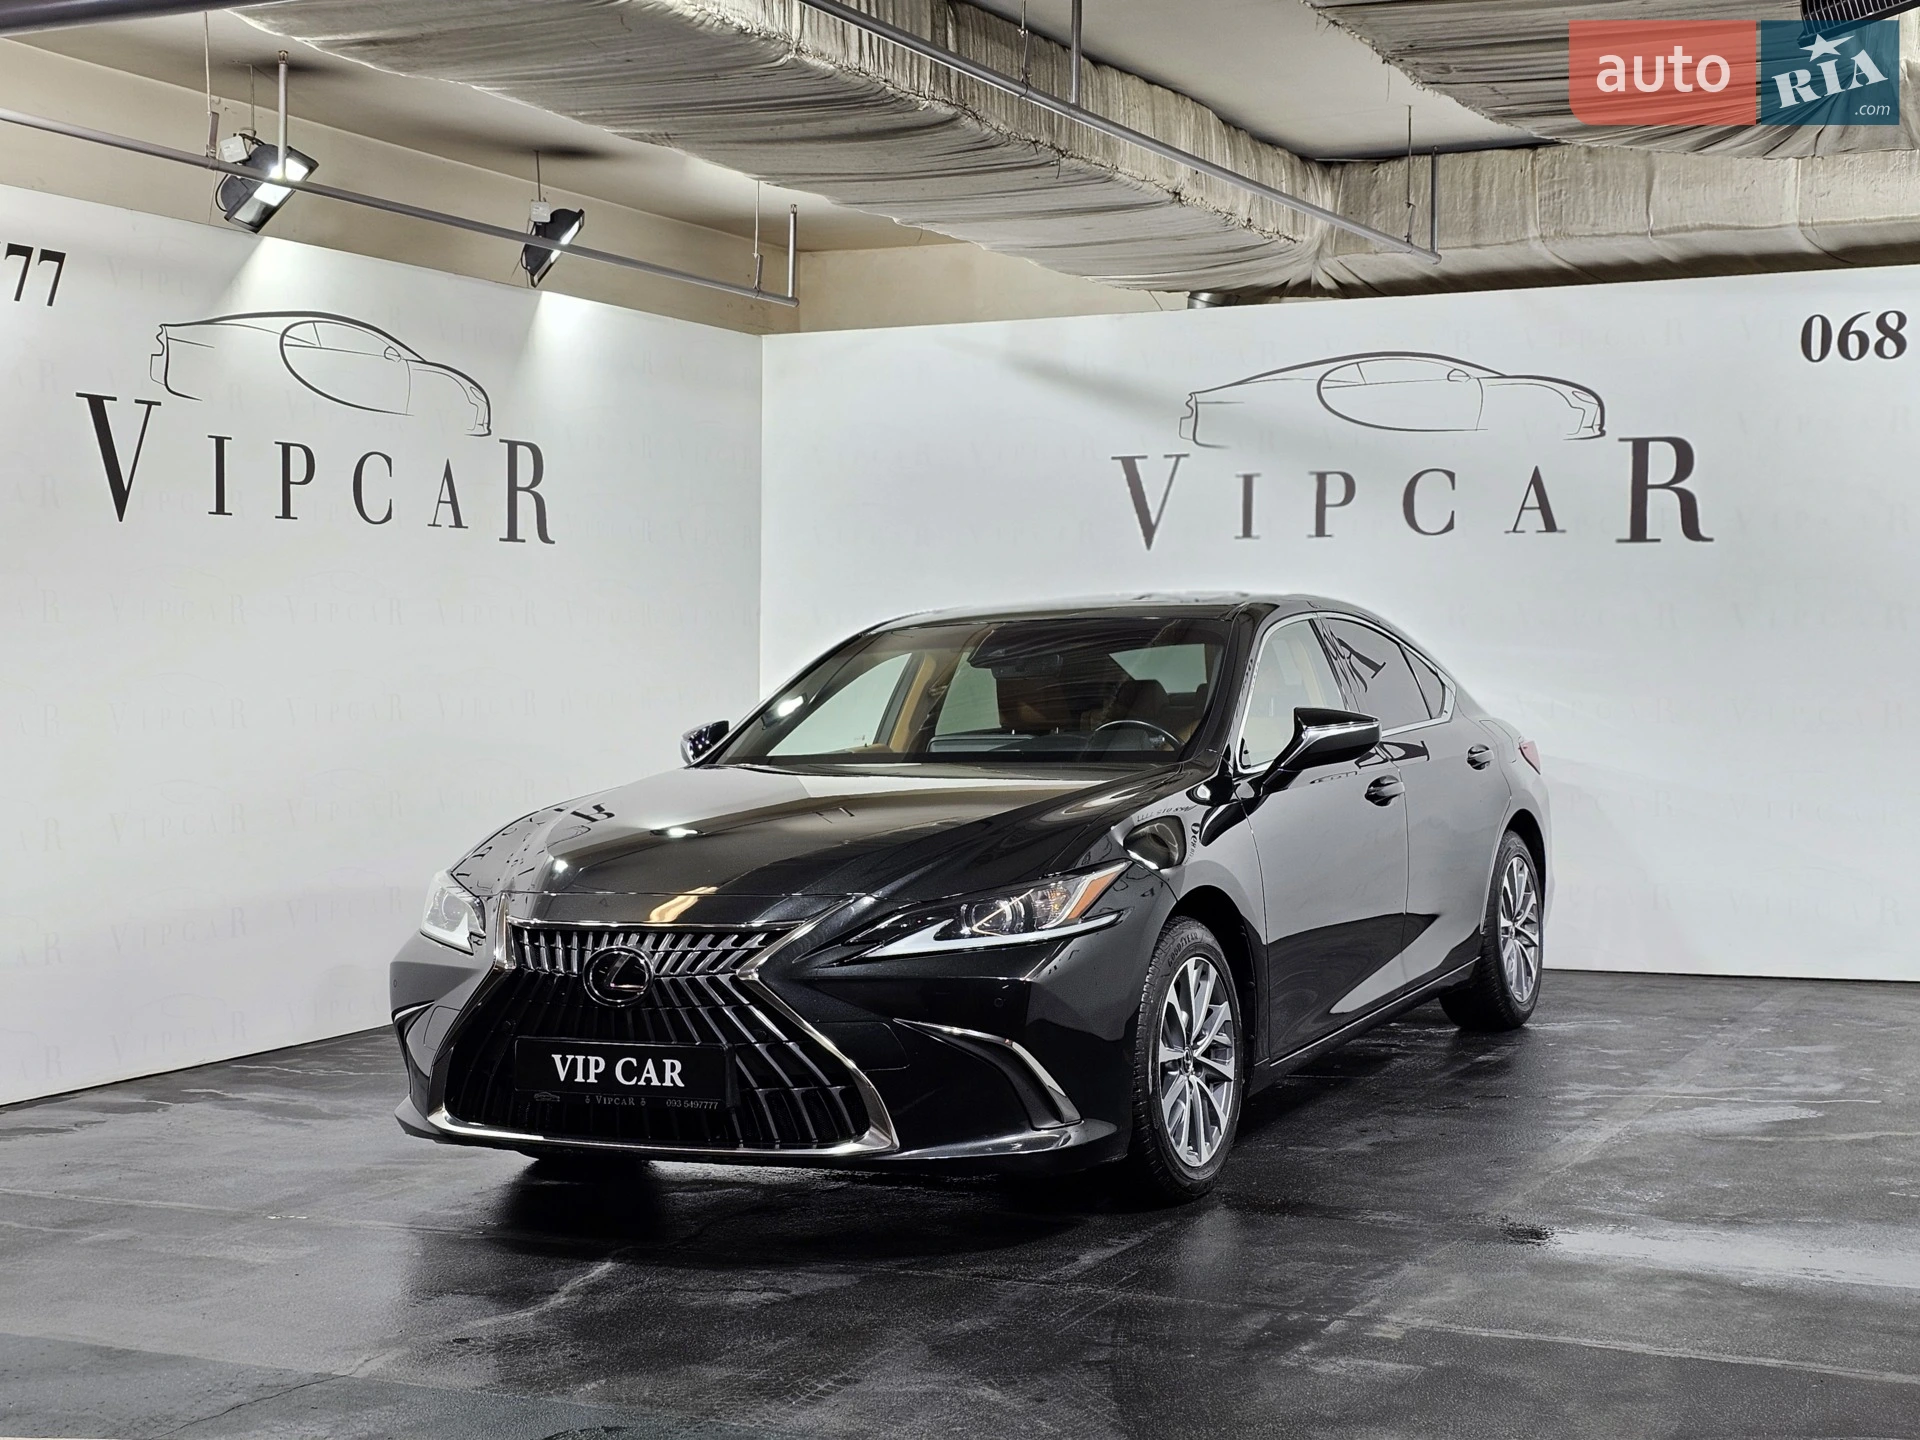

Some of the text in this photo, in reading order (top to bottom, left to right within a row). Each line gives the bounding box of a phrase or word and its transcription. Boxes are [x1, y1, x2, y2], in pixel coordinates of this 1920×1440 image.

[1799, 309, 1909, 363] 068
[75, 392, 556, 545] VIPCAR
[1111, 436, 1714, 551] VIPCAR
[551, 1053, 685, 1088] VIP CAR
[595, 1095, 636, 1106] VIPCAR
